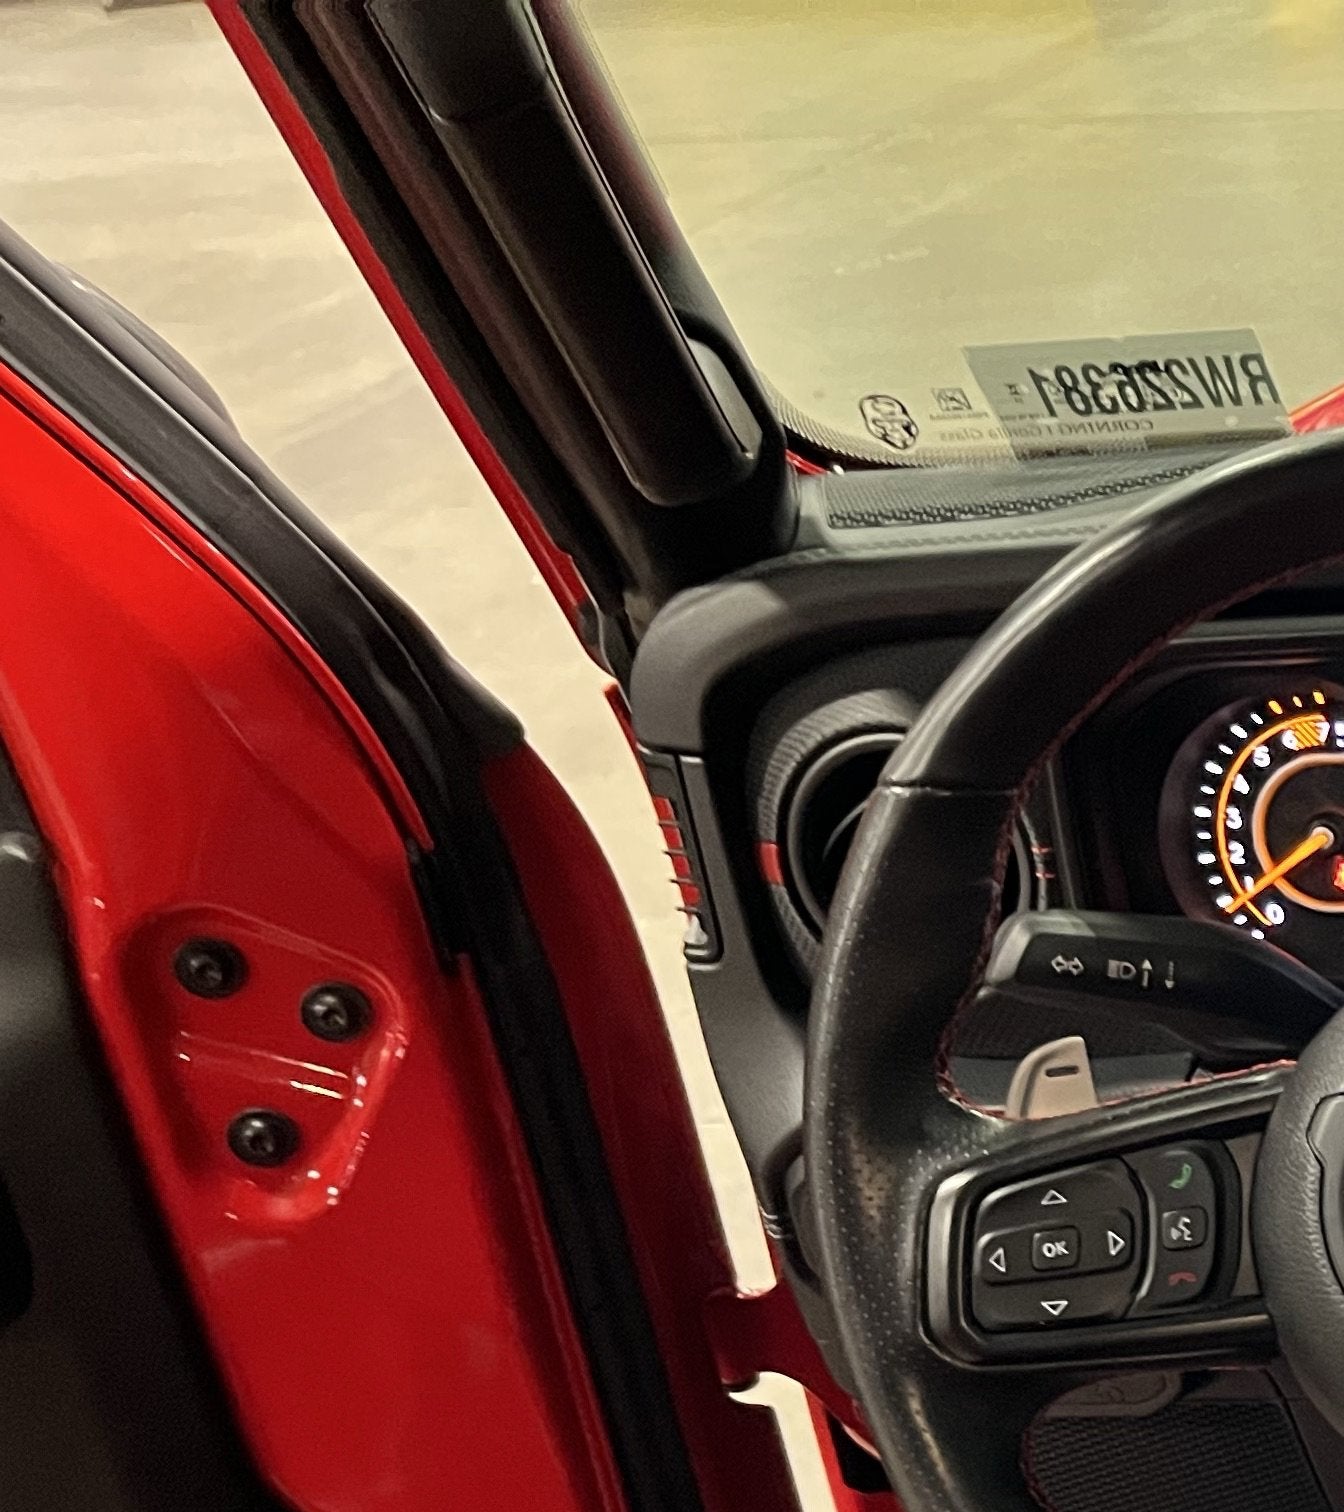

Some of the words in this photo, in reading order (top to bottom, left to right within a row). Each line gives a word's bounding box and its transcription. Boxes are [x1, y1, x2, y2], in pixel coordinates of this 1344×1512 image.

[1226, 806, 1243, 830] 3
[1228, 841, 1246, 865] 2
[1265, 902, 1286, 925] 0
[1042, 1240, 1069, 1259] OK
